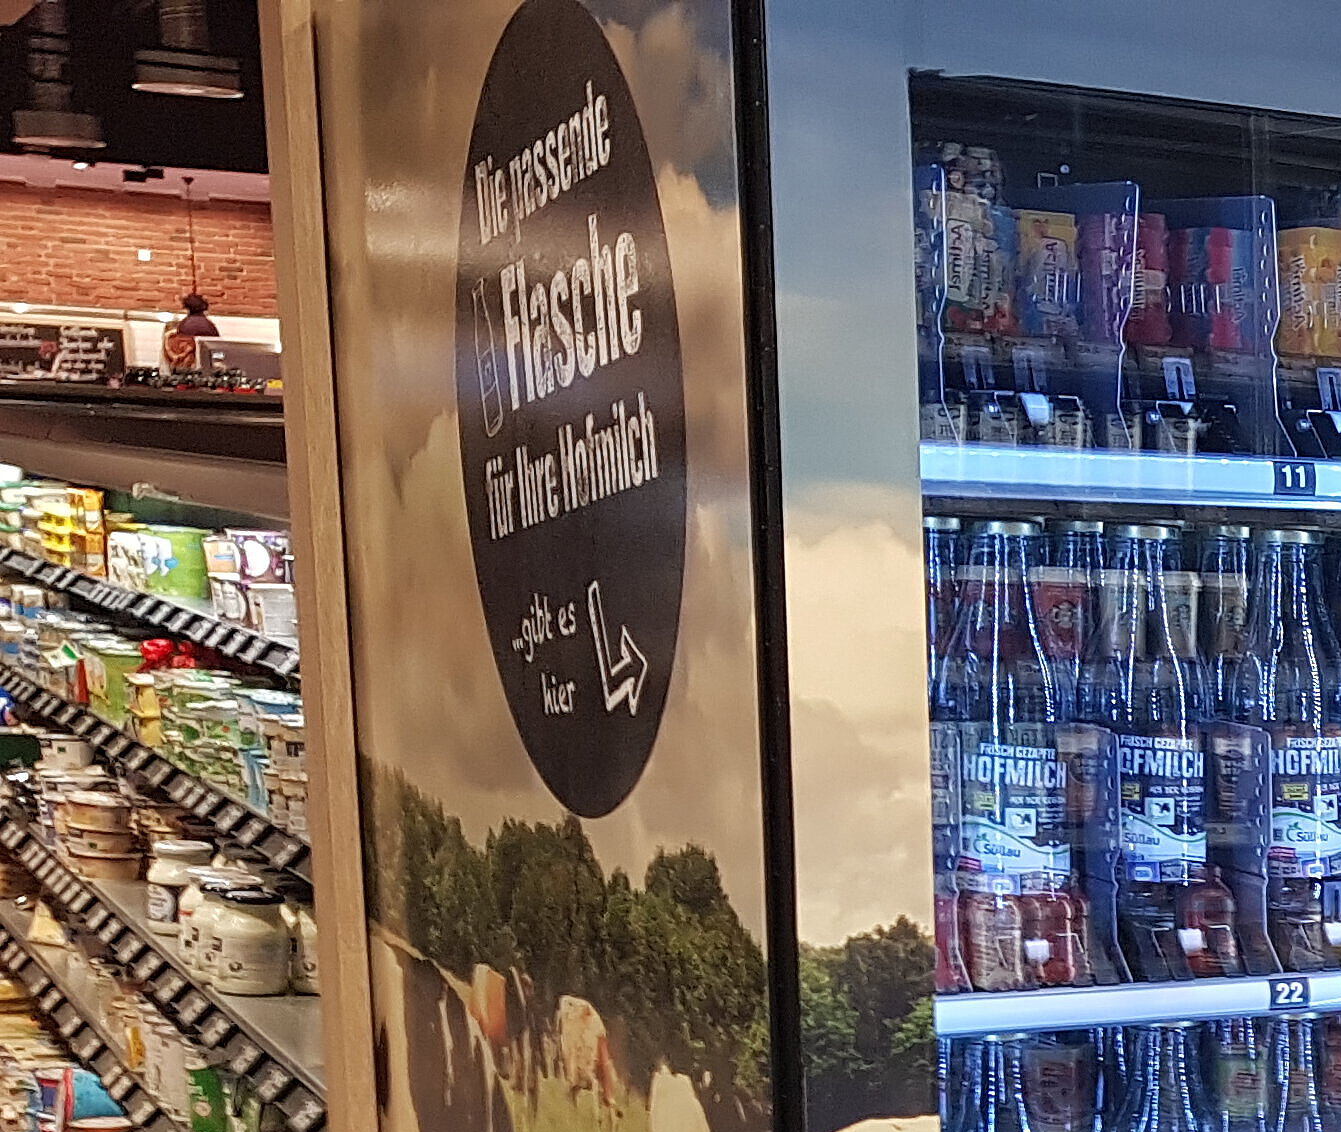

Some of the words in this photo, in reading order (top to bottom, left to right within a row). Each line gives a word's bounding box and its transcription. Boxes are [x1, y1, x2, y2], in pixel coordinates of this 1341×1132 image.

[474, 157, 507, 246] Die
[509, 81, 611, 240] passende
[501, 214, 641, 412] Flasche
[485, 458, 516, 540] für
[515, 434, 561, 530] Ihre
[562, 392, 658, 513] Hofmilch
[1281, 465, 1306, 488] 11
[556, 602, 577, 638] es
[542, 672, 576, 716] hier
[964, 753, 1067, 788] HOFMILCH
[1120, 748, 1204, 778] OFMILCH
[1275, 983, 1304, 1003] 22
